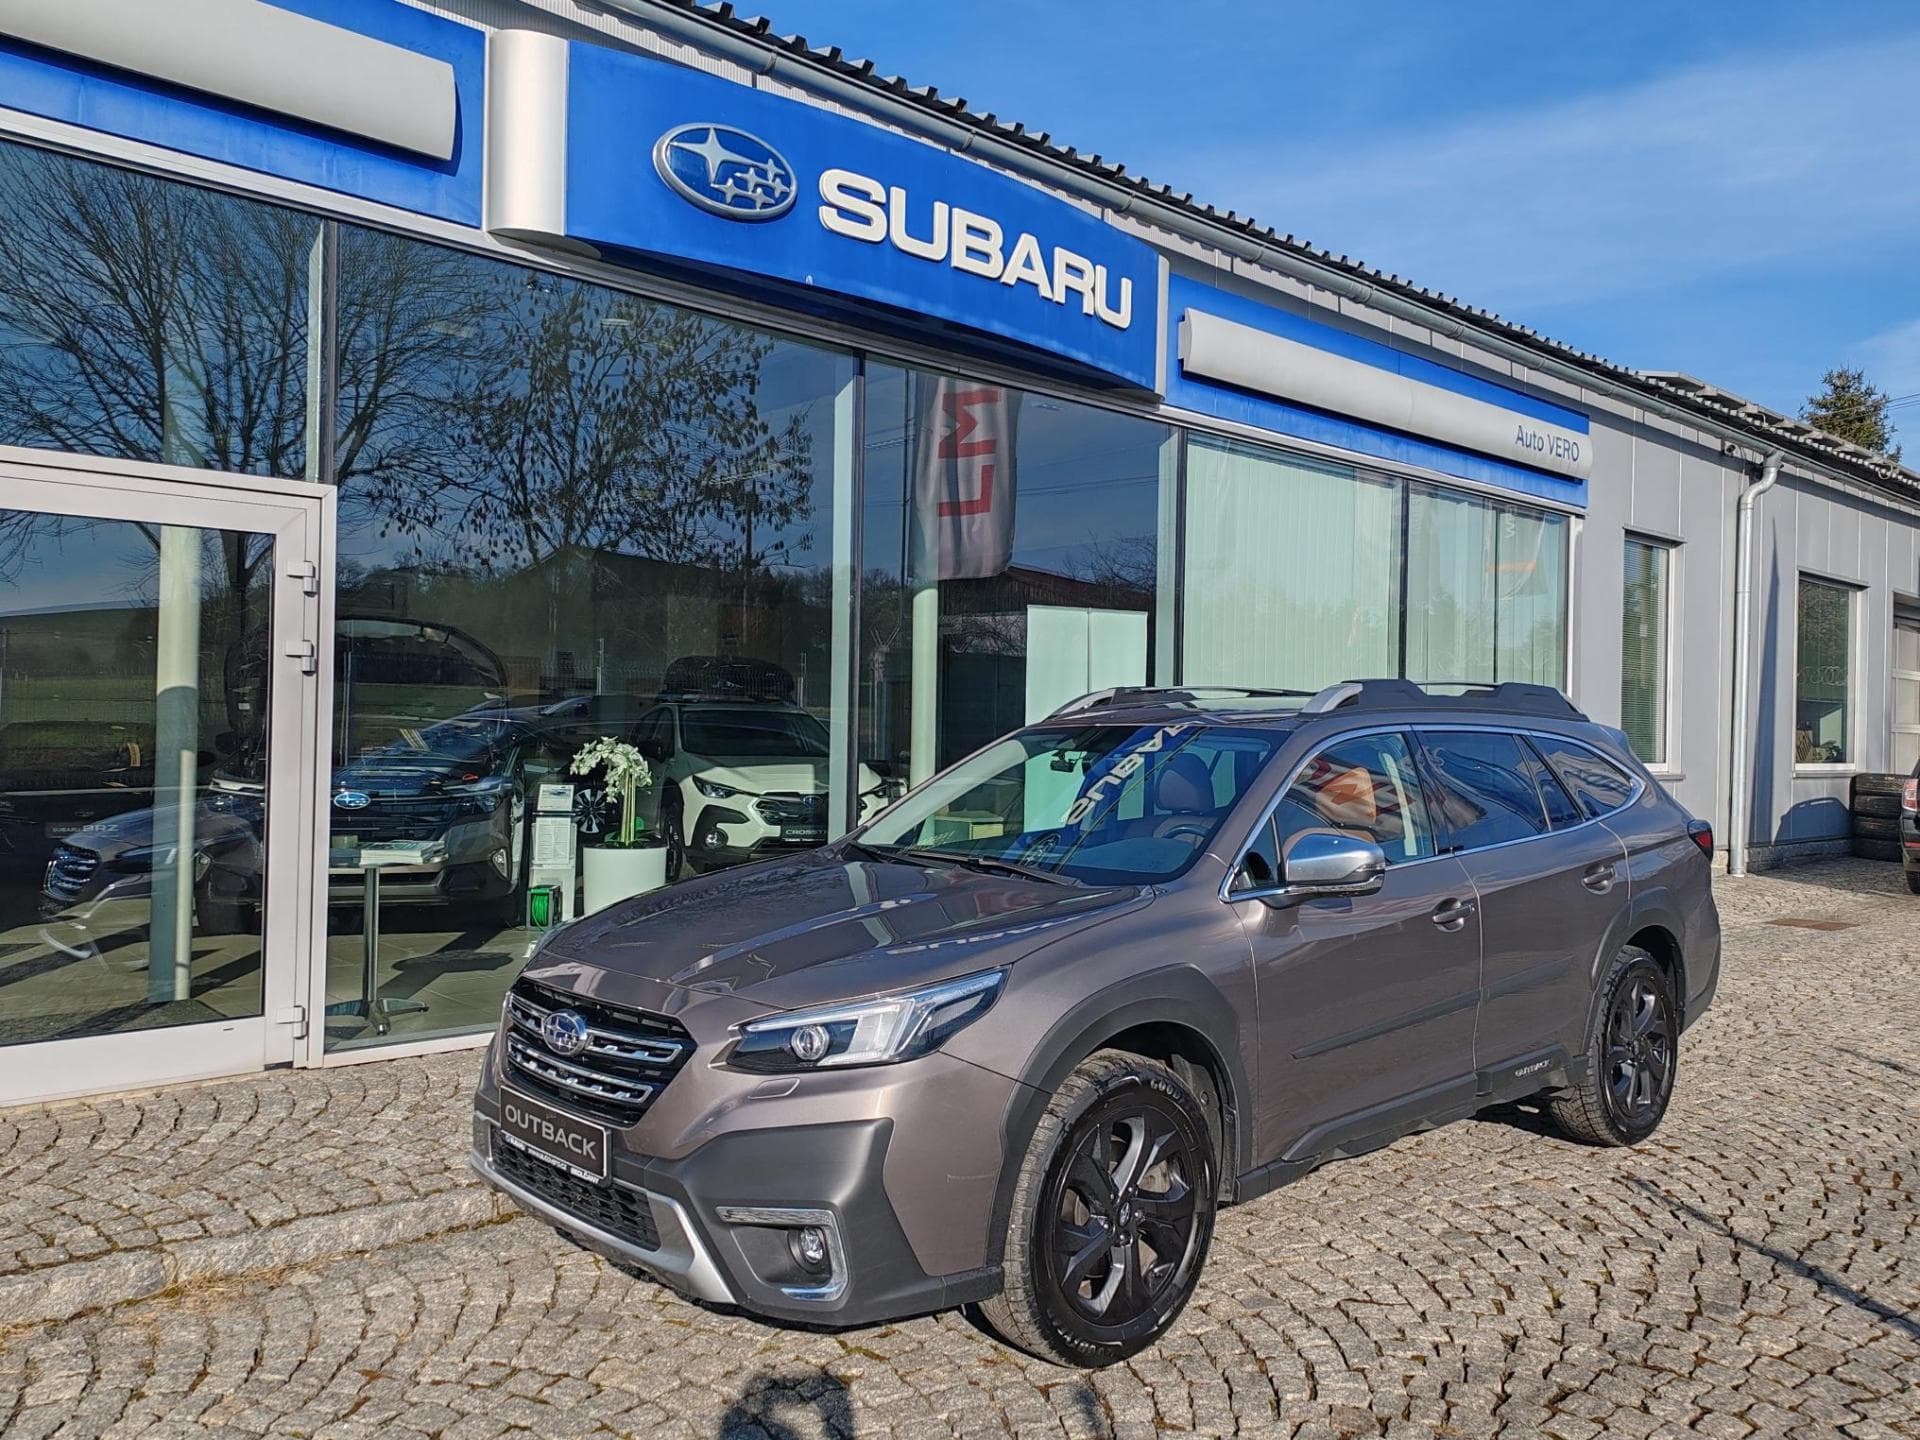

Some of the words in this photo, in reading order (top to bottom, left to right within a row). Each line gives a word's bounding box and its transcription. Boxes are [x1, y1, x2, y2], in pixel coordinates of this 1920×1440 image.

[818, 168, 1133, 330] SUBARU
[1515, 425, 1545, 452] Auto
[1547, 434, 1580, 462] VERO
[505, 1104, 597, 1160] OUTBACK
